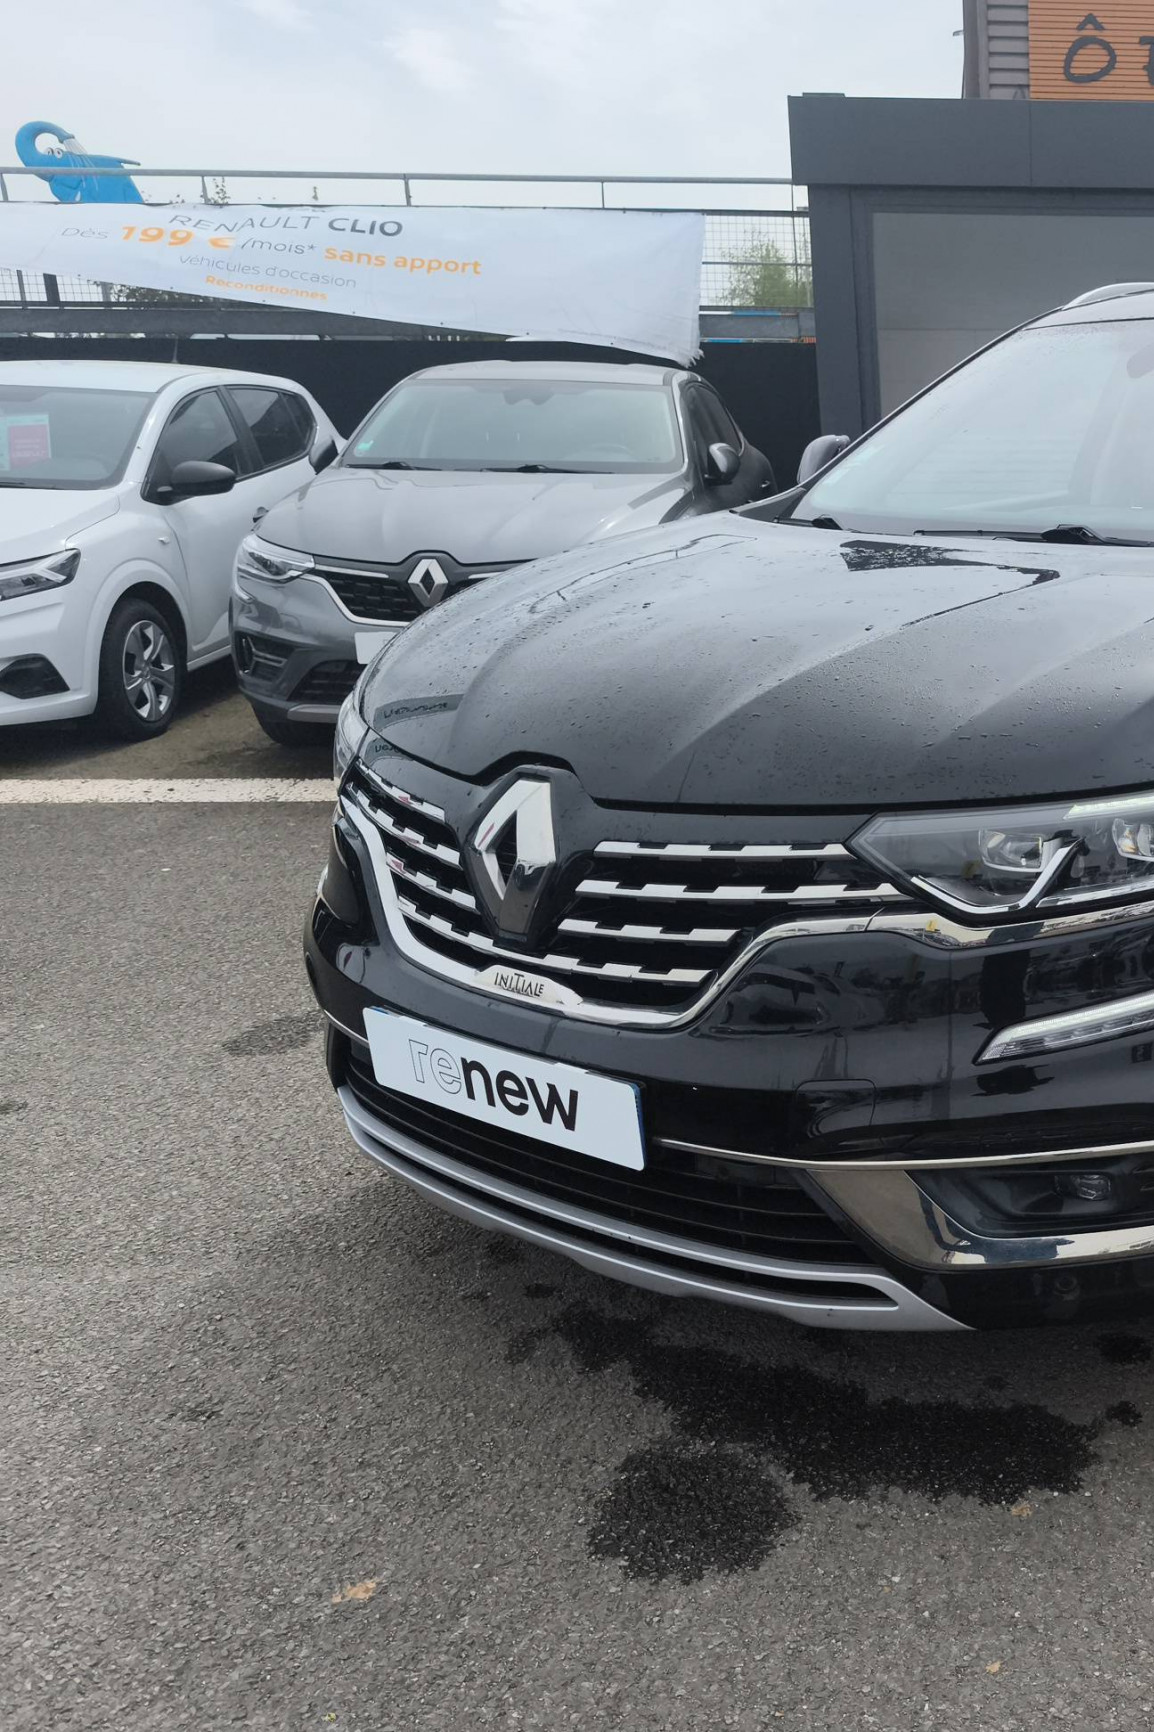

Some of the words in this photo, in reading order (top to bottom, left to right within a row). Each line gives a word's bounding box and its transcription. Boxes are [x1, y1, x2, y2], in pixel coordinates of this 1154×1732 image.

[1063, 12, 1118, 83] Ô
[121, 225, 196, 247] 199
[207, 235, 237, 250] €
[324, 246, 387, 268] sans
[393, 254, 483, 276] apport
[168, 213, 321, 234] RENAULT
[328, 217, 404, 238] CLIO
[493, 971, 545, 997] INITIALE
[407, 1038, 579, 1132] renew
